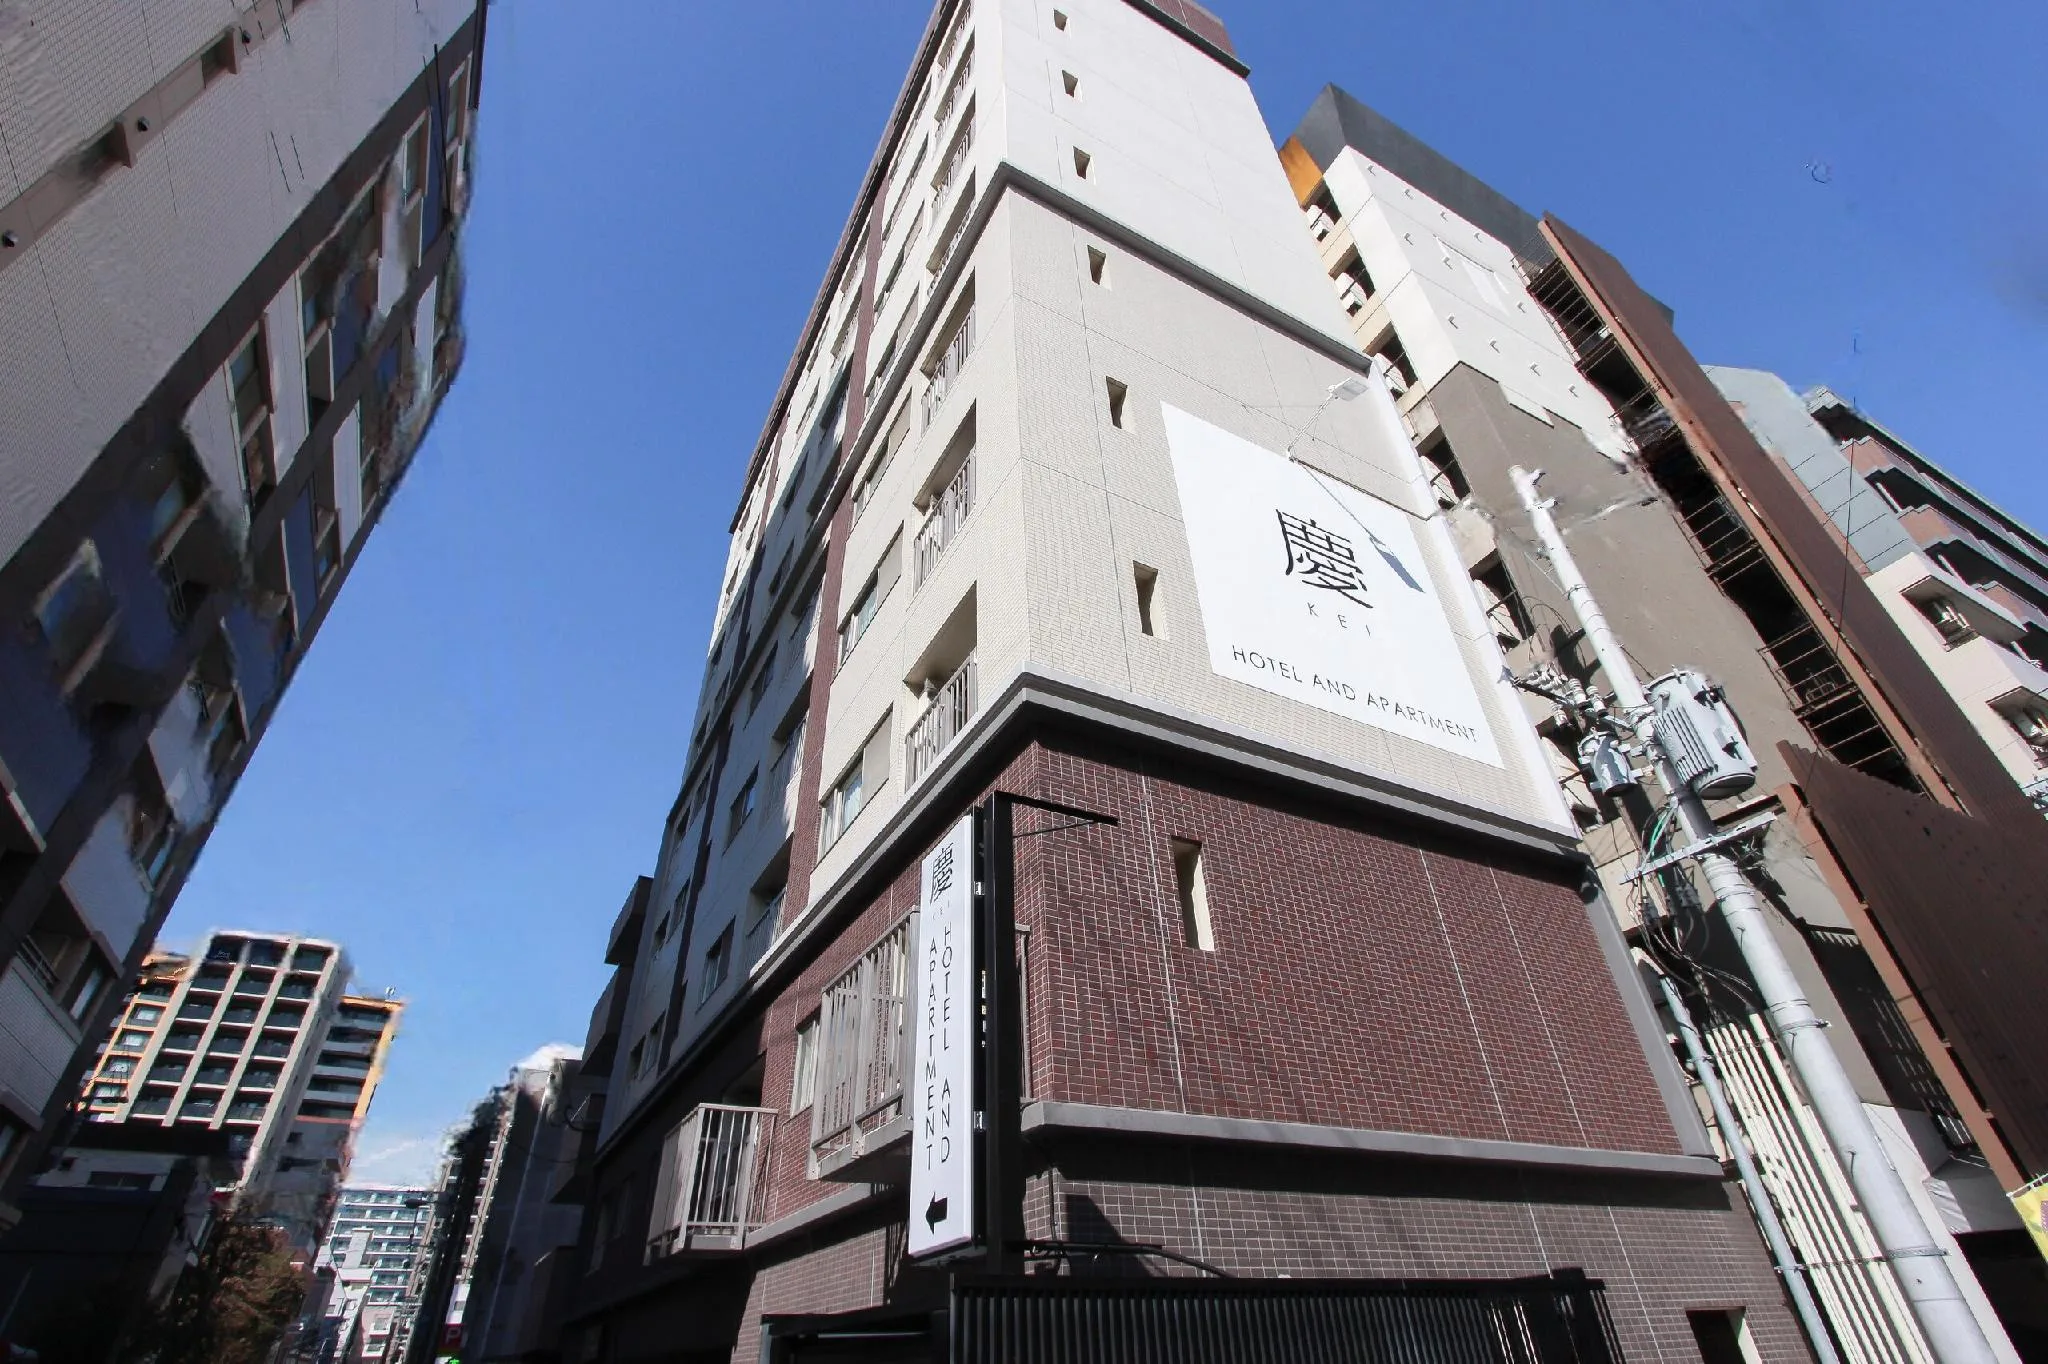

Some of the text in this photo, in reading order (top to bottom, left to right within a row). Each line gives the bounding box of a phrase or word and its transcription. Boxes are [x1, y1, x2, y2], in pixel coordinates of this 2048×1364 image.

[1275, 509, 1374, 608] 慶
[1307, 602, 1372, 637] KEI
[1232, 645, 1478, 743] HOTEL AND APARTMENT
[929, 842, 954, 906] 慶
[925, 936, 937, 1171] APARTMENT
[941, 920, 952, 1164] HOTEL AND
